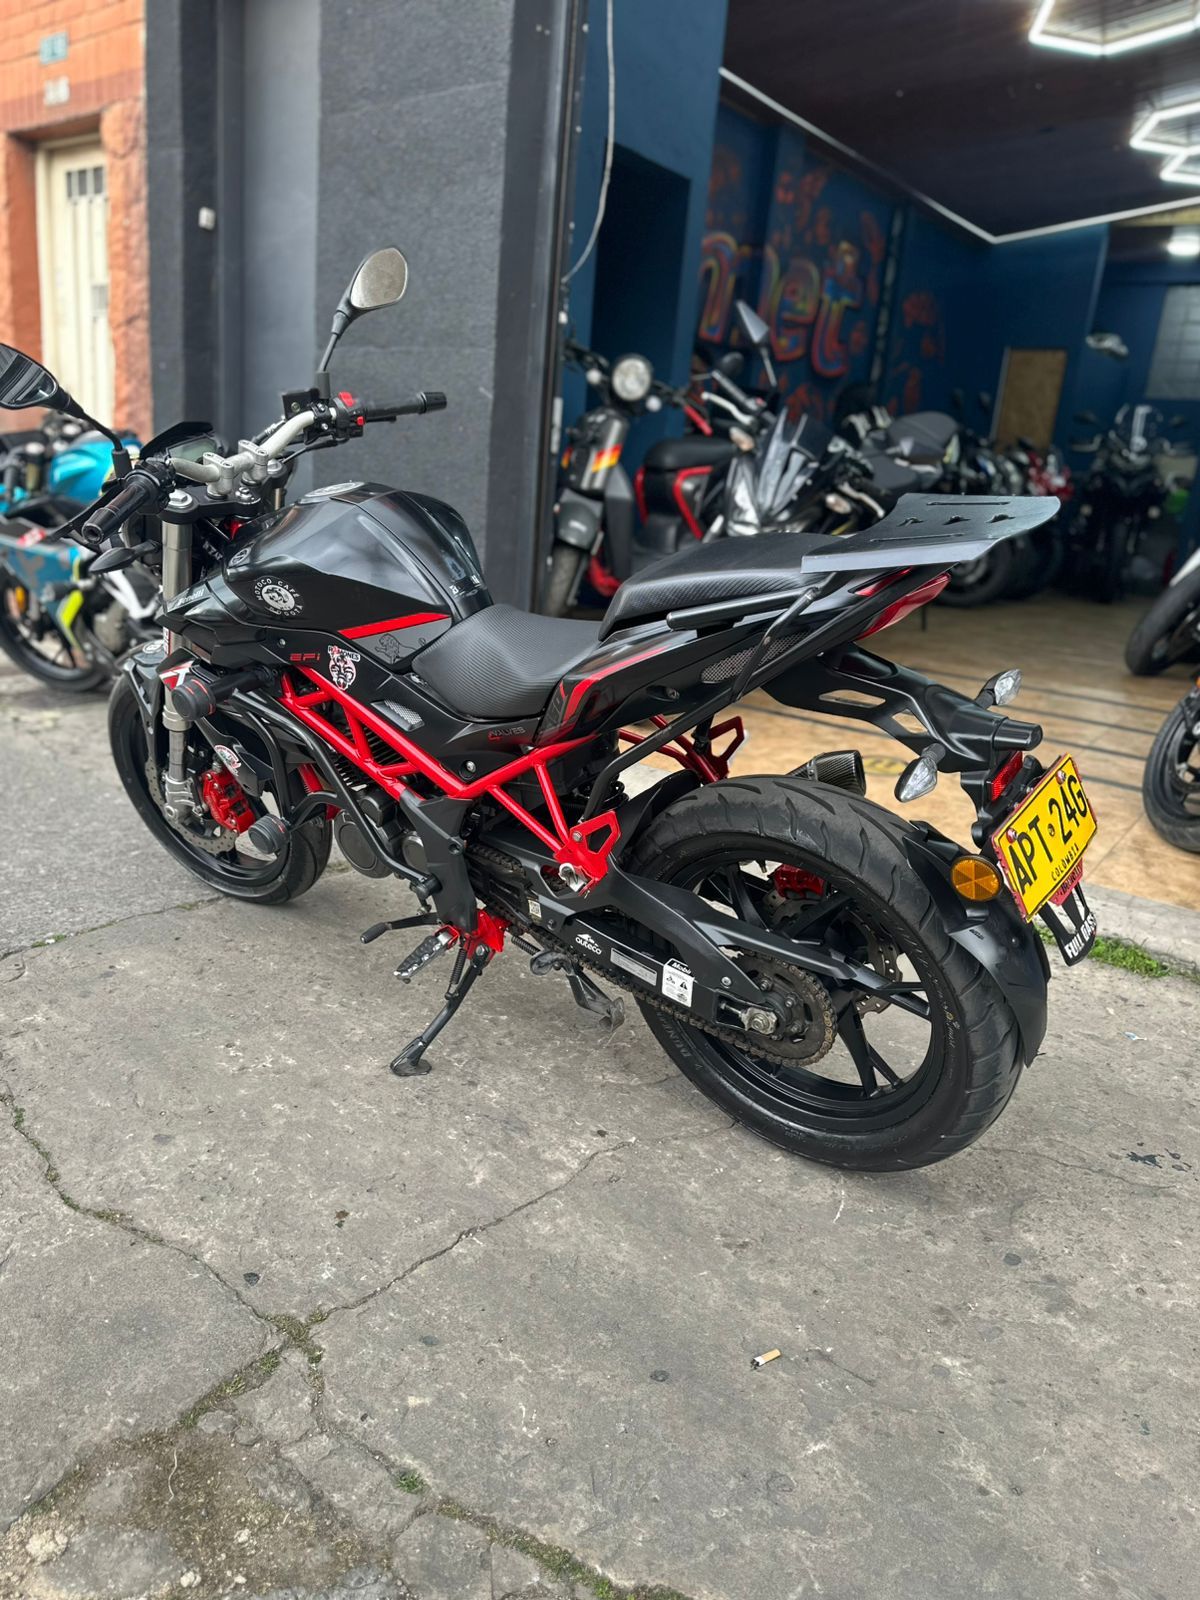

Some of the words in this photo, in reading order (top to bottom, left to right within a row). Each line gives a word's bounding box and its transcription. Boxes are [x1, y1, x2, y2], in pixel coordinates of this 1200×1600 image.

[1007, 815, 1054, 895] APT
[1048, 774, 1088, 846] 24G
[1050, 842, 1080, 882] COLOMBIA
[575, 936, 602, 955] auteco
